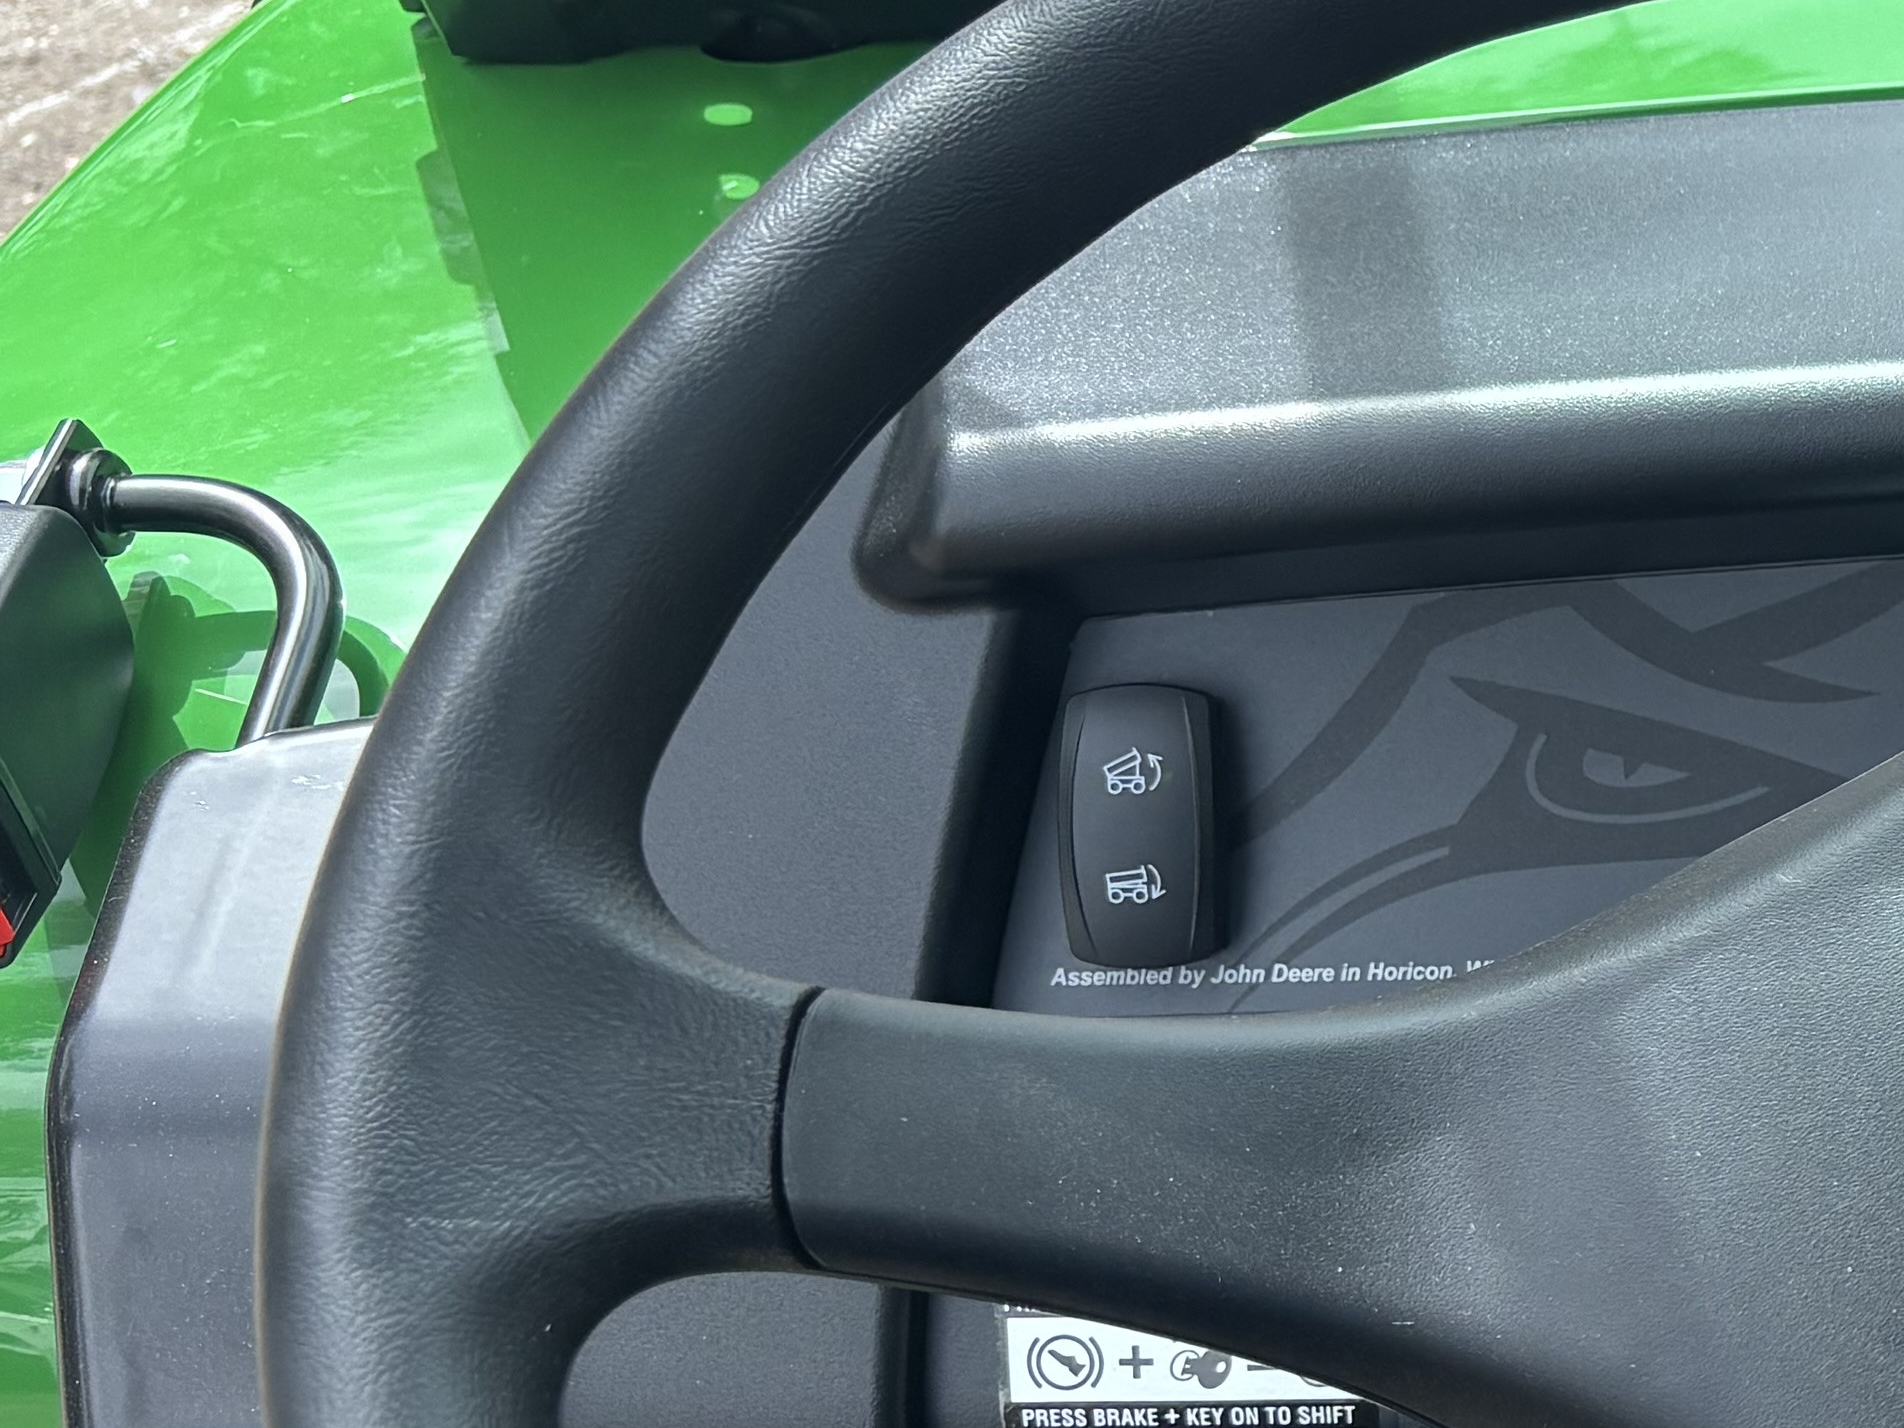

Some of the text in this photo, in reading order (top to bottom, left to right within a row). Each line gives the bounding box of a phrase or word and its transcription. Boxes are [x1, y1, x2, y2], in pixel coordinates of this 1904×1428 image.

[1050, 966, 1172, 987] Assembled
[1178, 965, 1205, 989] by
[1210, 964, 1265, 984] John
[1271, 963, 1335, 983] Deere
[1340, 963, 1361, 982] in
[1022, 1409, 1087, 1428] PRESS
[1094, 1408, 1159, 1427] BRAKE
[1186, 1407, 1224, 1426] KEY
[1231, 1406, 1259, 1426] ON
[1264, 1406, 1292, 1425] TO
[1298, 1405, 1356, 1425] SHIFT
